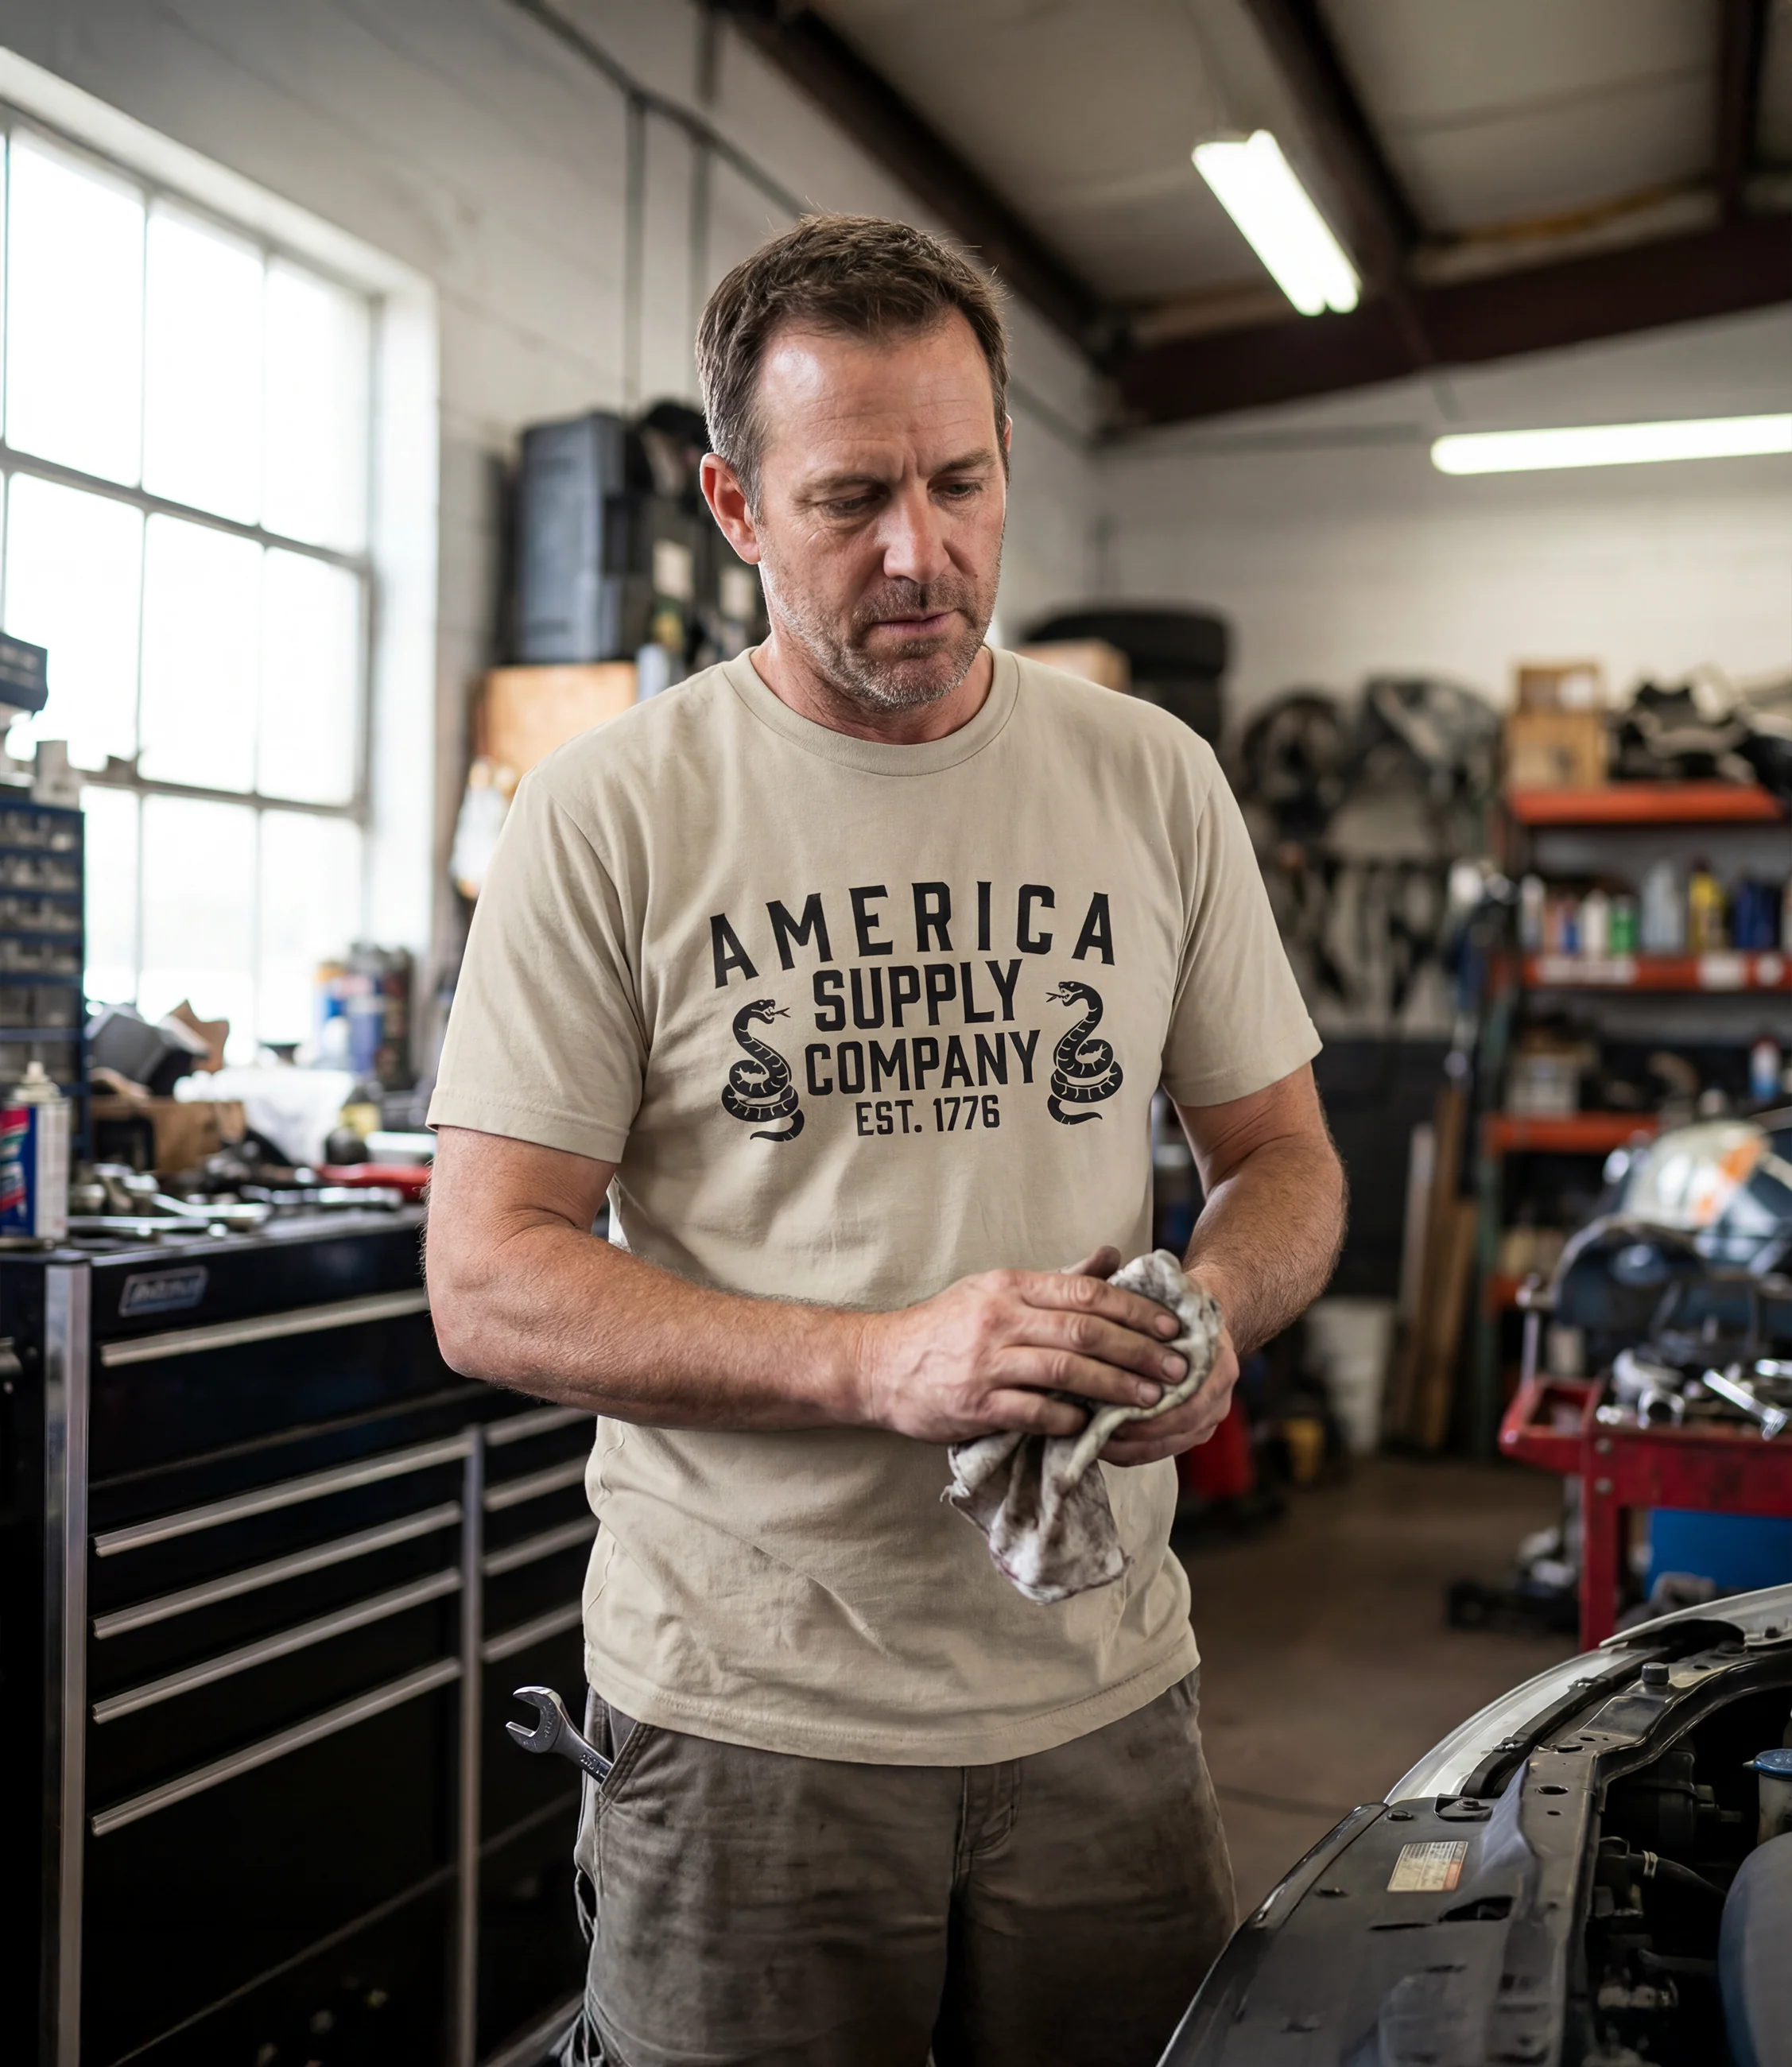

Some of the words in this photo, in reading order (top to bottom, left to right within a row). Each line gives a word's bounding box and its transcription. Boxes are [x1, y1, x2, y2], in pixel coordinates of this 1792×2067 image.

[709, 881, 1115, 989] AMERICA
[812, 958, 1023, 1032] SUPPLY
[805, 1029, 1041, 1096] COMPANY
[855, 1099, 923, 1137] EST.
[933, 1094, 1000, 1132] 1776
